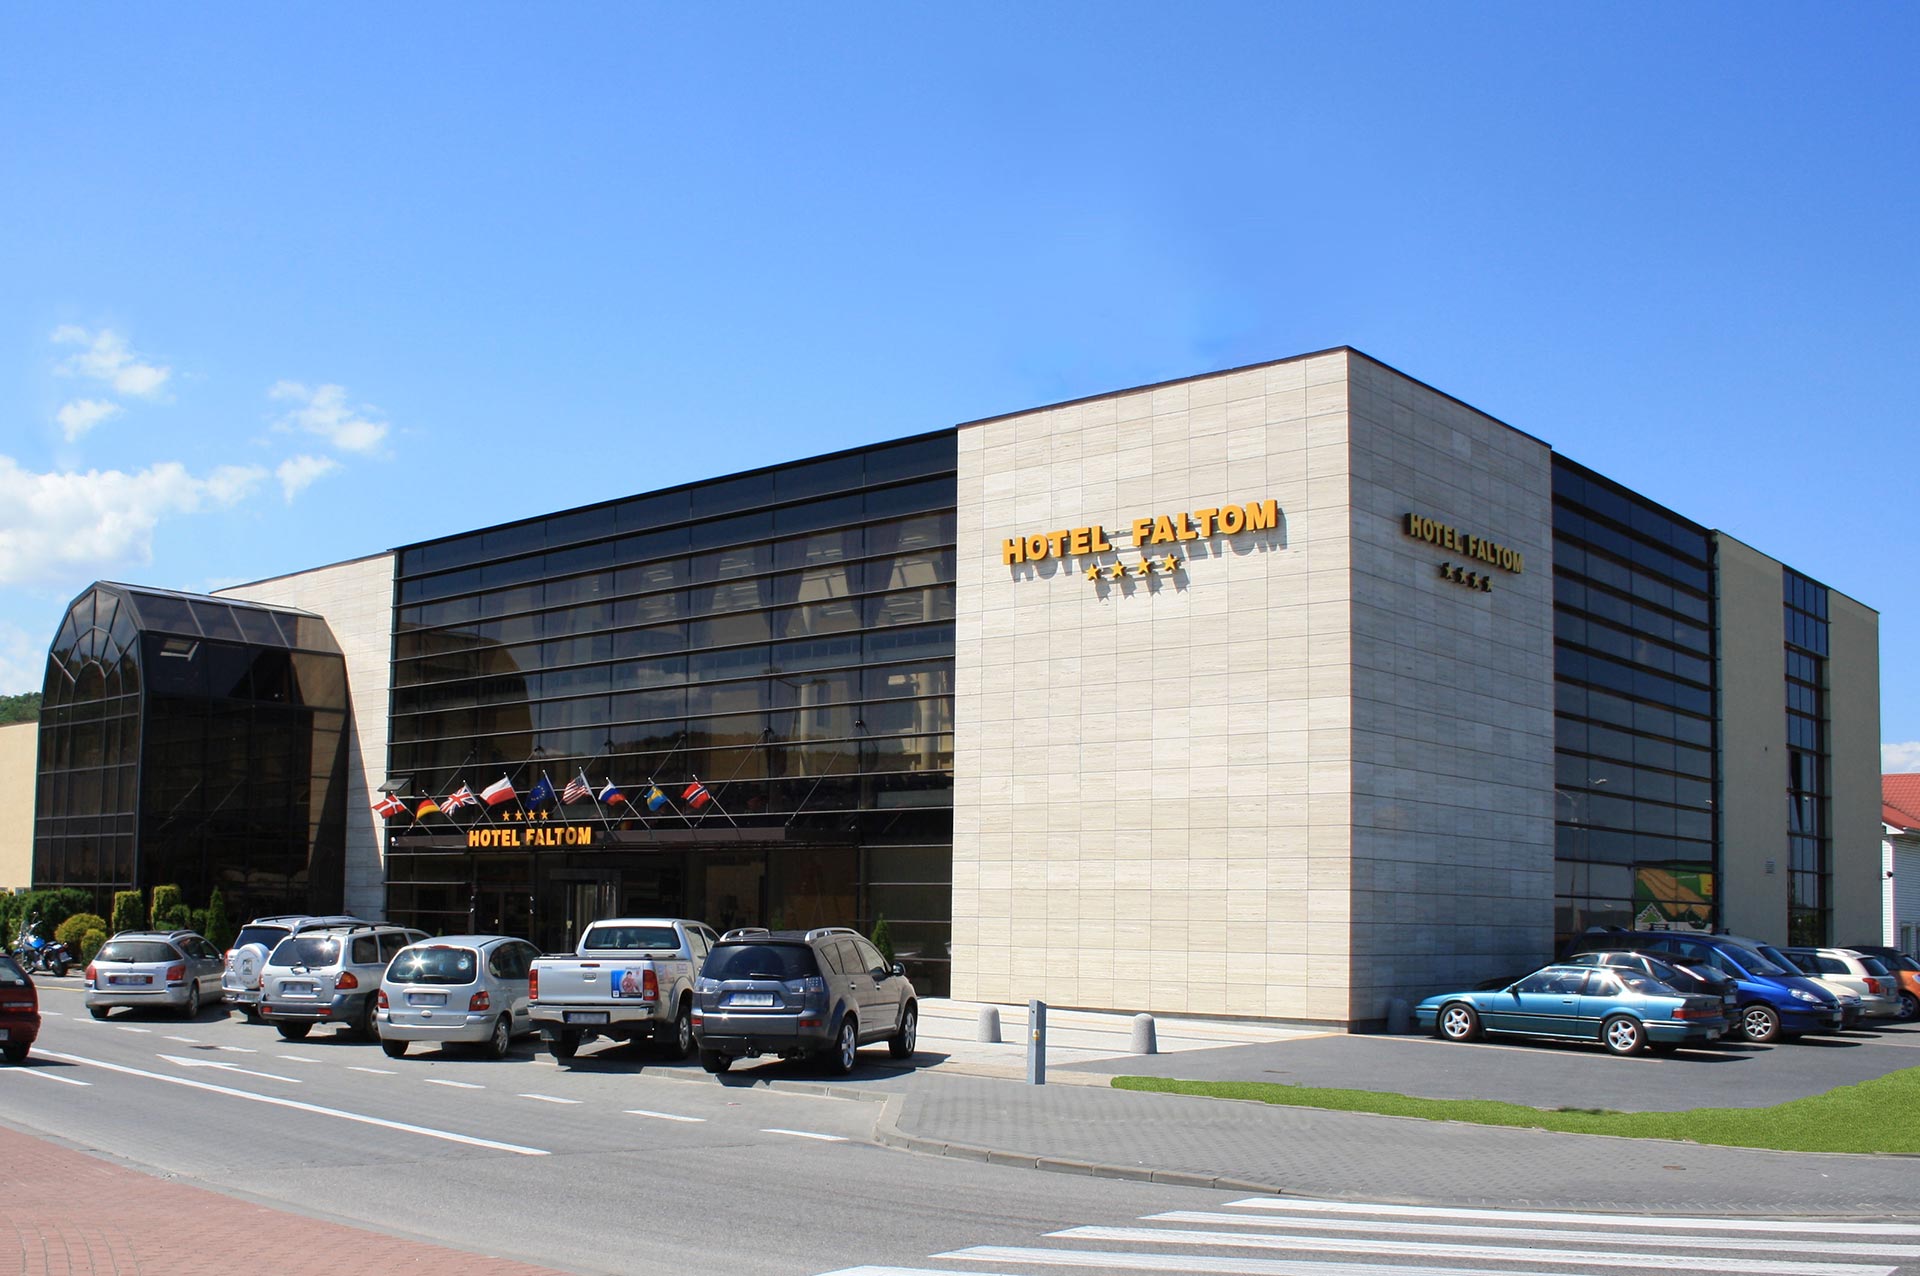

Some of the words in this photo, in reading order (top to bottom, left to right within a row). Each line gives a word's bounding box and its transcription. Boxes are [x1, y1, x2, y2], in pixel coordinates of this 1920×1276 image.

[1002, 525, 1112, 565] HOTEL
[1132, 499, 1278, 546] FALTOM
[1409, 513, 1463, 552] HOTEL
[1468, 534, 1524, 573] FALTOM
[468, 828, 520, 847] HOTEL
[525, 826, 592, 846] FALTOM
